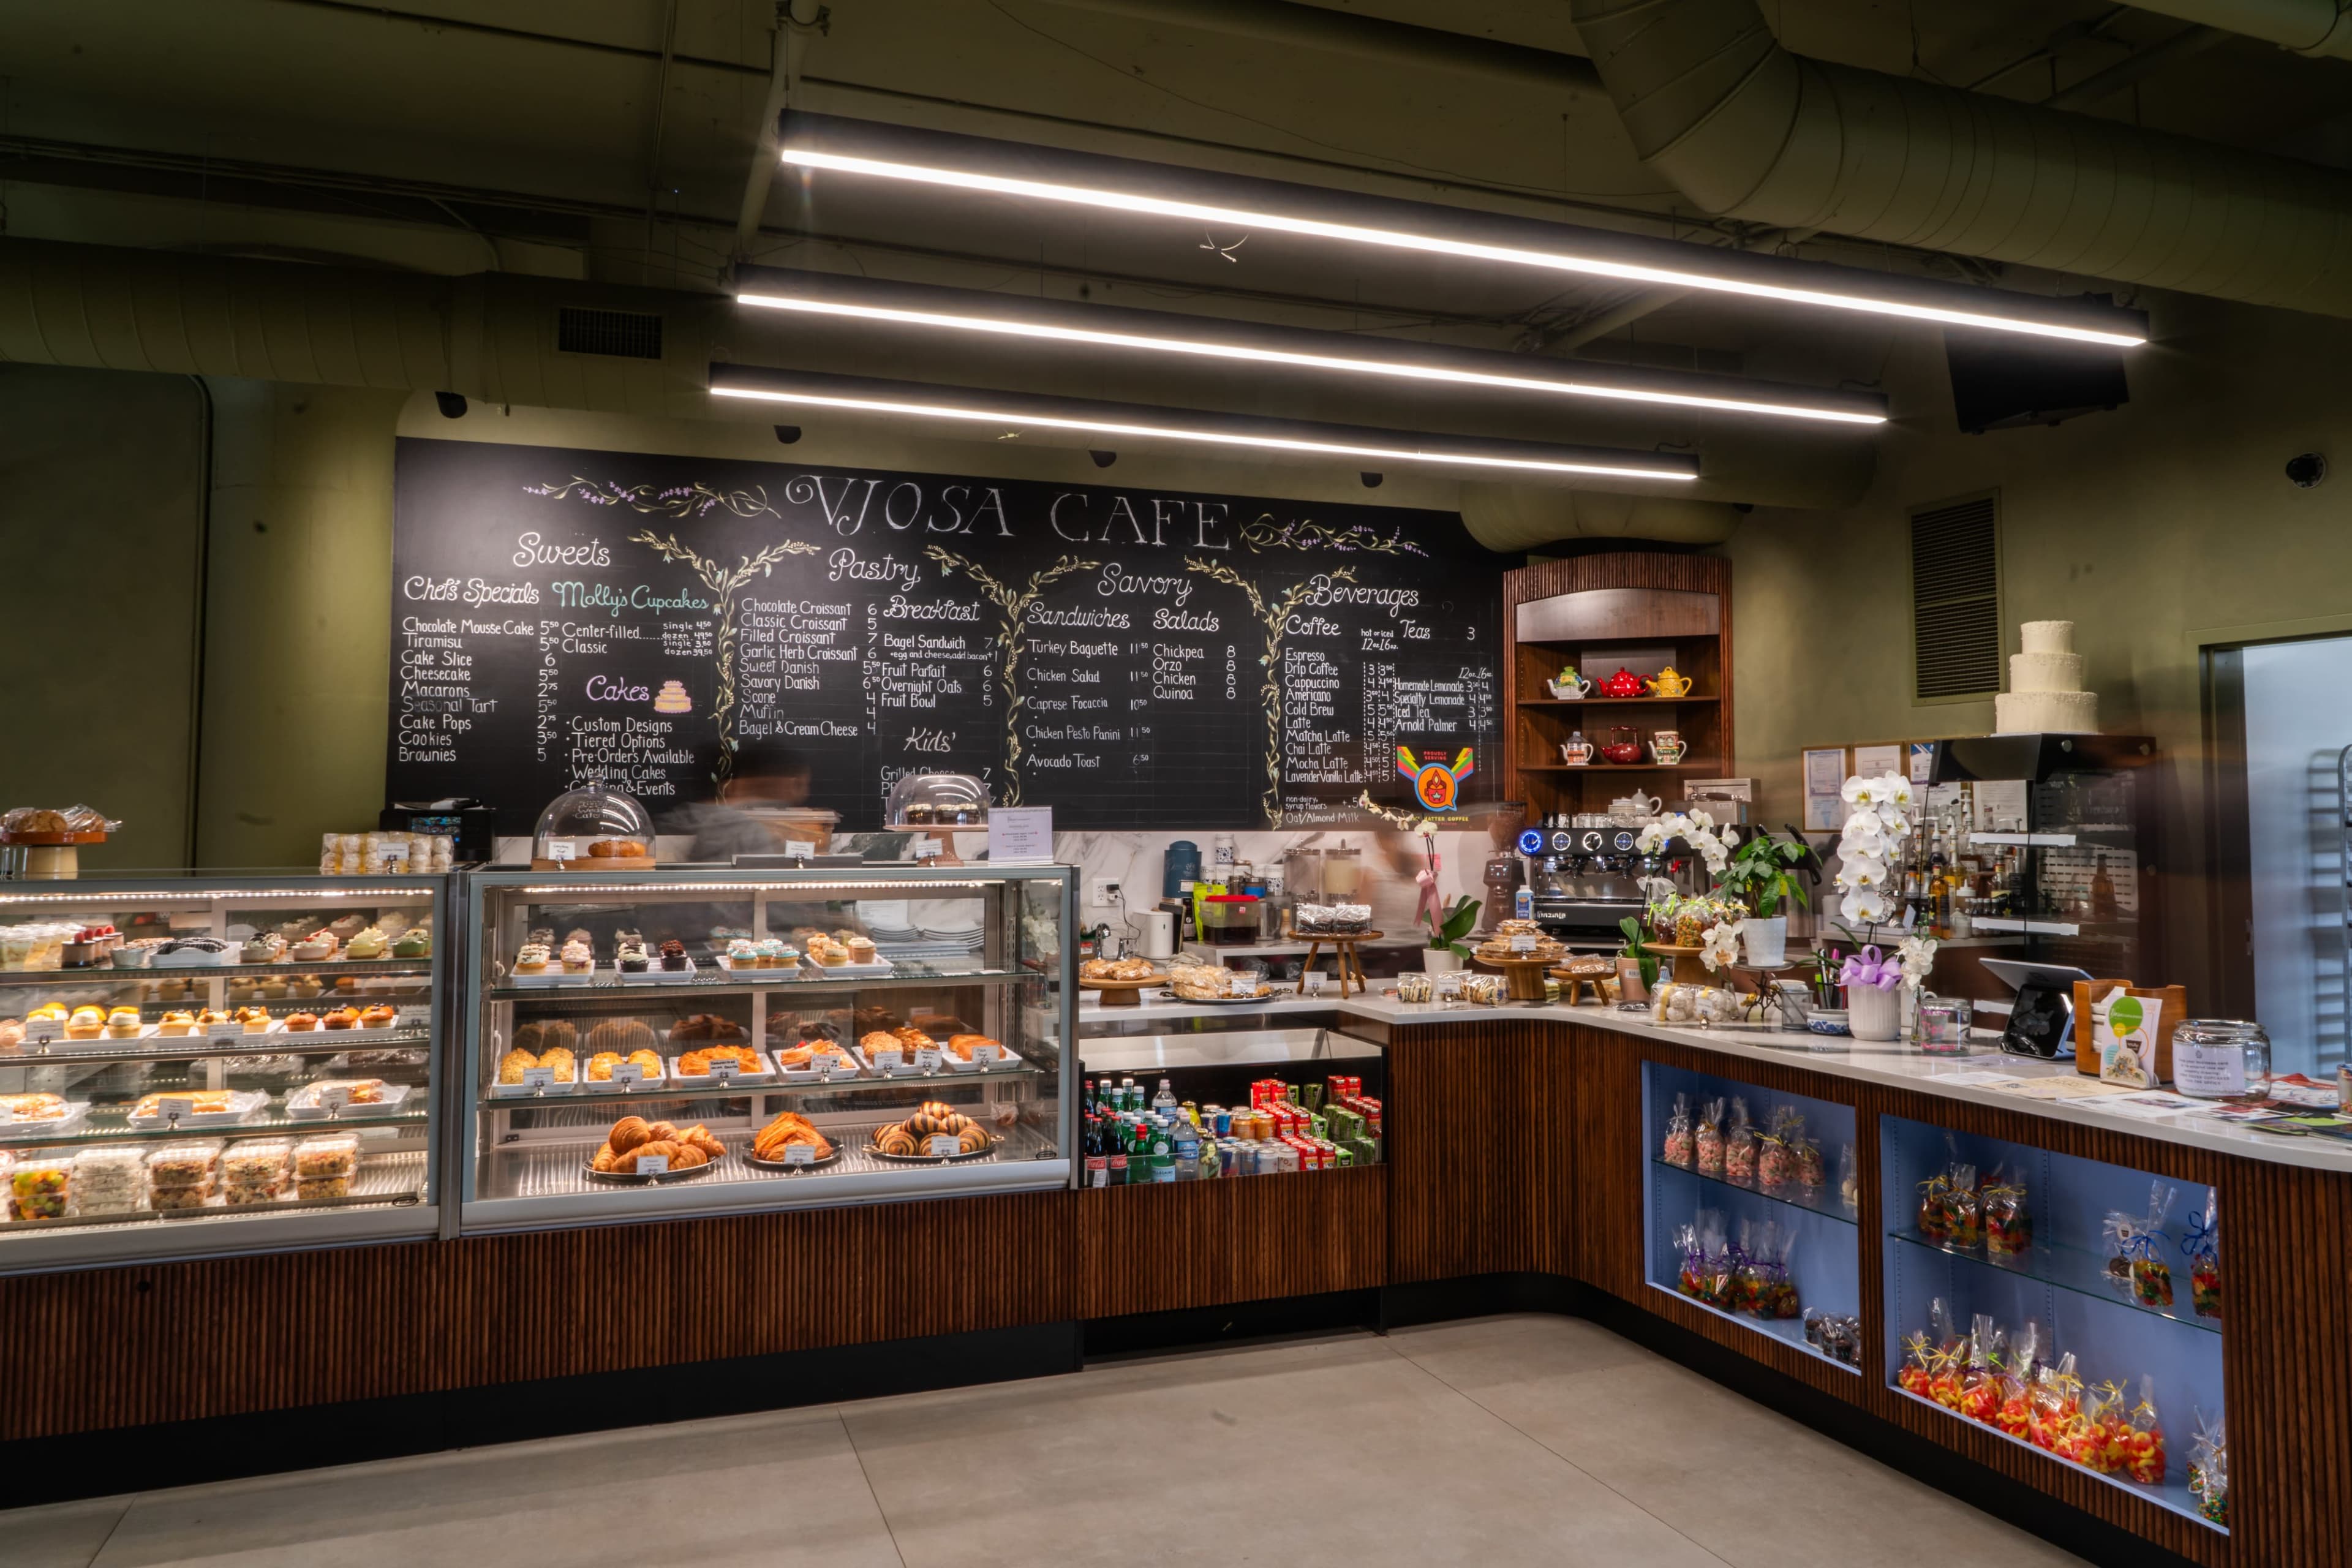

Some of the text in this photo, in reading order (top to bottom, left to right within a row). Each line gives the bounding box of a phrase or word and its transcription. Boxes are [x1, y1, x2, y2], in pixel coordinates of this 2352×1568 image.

[785, 475, 1231, 550] VJOSA CAFE
[512, 532, 610, 567] Sweets
[828, 548, 921, 591] Pastry
[404, 576, 539, 608] Chef's Specials
[1098, 563, 1193, 606] Savory
[551, 581, 709, 617] Molly's Cupcakes
[1305, 575, 1419, 617] Beverages
[742, 598, 877, 615] Chocolate Croissant 6
[883, 595, 979, 620] Breakfast
[741, 612, 876, 630] Classic Croissant 5
[1027, 602, 1130, 628] Sandwiches
[1153, 608, 1219, 631] Salads
[403, 617, 533, 635] Chocolate Mousse Cake
[663, 622, 693, 631] single
[1286, 614, 1341, 635] Coffee
[1400, 619, 1475, 640] Teas 3
[402, 633, 462, 648] Tiramisu
[663, 639, 691, 649] single
[741, 628, 877, 644] Filled Croissant 7
[884, 633, 993, 650] Bagel Sandwich 7
[562, 638, 607, 653] Classic
[741, 643, 876, 661] Garlic Herb Croissant 6
[1027, 639, 1118, 658] Turkey Baguette
[1153, 644, 1235, 661] Chickpea 8
[401, 650, 555, 666] Cake Slice 6
[1153, 657, 1235, 671] Orzo 8
[1285, 647, 1325, 669] Espresso
[401, 666, 470, 680] Cheesecake
[740, 660, 819, 674] Sweet Danish
[883, 663, 992, 677] Fruit Parfait 6
[1027, 668, 1100, 682] Chicken Salad
[1285, 662, 1338, 677] Drip Coffee
[741, 674, 819, 693] Savory Danish
[1153, 671, 1235, 685] Chicken 8
[1286, 677, 1339, 691] Cappuccino
[1394, 678, 1464, 692] Homemade Lemonade
[402, 681, 470, 699] Macarons
[586, 675, 649, 701] Cakes
[882, 679, 991, 696] Overnight Oats 6
[1153, 685, 1235, 699] Quinoa 8
[742, 688, 875, 704] Scone 4
[882, 693, 992, 707] Fruit Bowl 5
[1286, 690, 1331, 703] Americano
[1394, 691, 1464, 707] Specialty Lemonade
[402, 698, 498, 712] Seasonal Tart
[740, 704, 875, 719] Muffin 4
[1027, 695, 1107, 714] Caprese Focaccia
[1285, 702, 1333, 715] Cold Brew
[1395, 706, 1430, 718] Iced Tea
[400, 714, 471, 734] Cake Pops
[572, 716, 672, 737] Custom Designs
[739, 720, 772, 740] Bagel
[785, 722, 819, 735] Cream
[821, 721, 858, 736] Cheese
[867, 722, 875, 734] 4
[1286, 717, 1310, 728] Latte
[1394, 718, 1457, 731] Arnold Palmer
[399, 731, 451, 747] Cookies
[1027, 725, 1120, 740] Chicken Pesto Panini
[1286, 729, 1349, 742] Matcha Latte
[571, 733, 665, 752] Tiered Options
[1286, 742, 1331, 755] Chai Latte
[399, 747, 546, 761] Brownies 5
[573, 748, 694, 763] Pre-Orders Available
[1027, 753, 1100, 767] Avocado Toast
[1286, 756, 1348, 769] Mocha Latte
[632, 765, 665, 779] Cakes
[881, 766, 916, 782] Grilled
[1286, 771, 1363, 783] Lavender Vanilla Latte
[1286, 801, 1327, 813] syrup flavors
[1338, 812, 1359, 823] Milk
